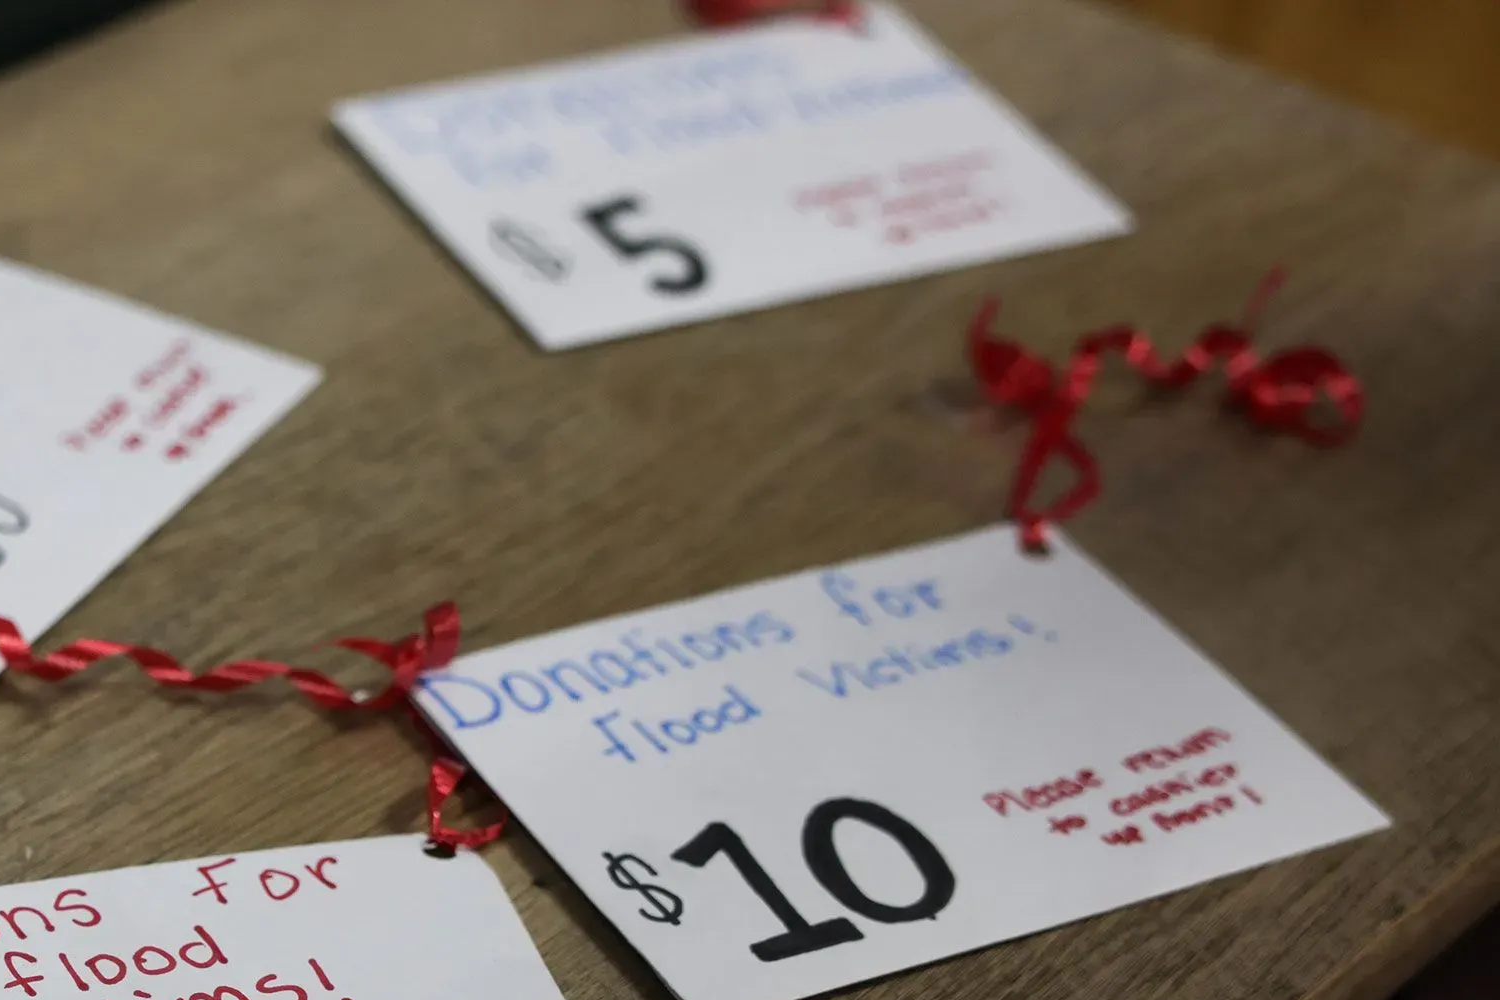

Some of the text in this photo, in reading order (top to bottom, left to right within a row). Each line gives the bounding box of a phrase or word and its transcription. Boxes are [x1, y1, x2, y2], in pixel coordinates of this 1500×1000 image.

[417, 569, 946, 729] Donations for
[982, 768, 1103, 817] Please
[2, 924, 230, 997] flood
